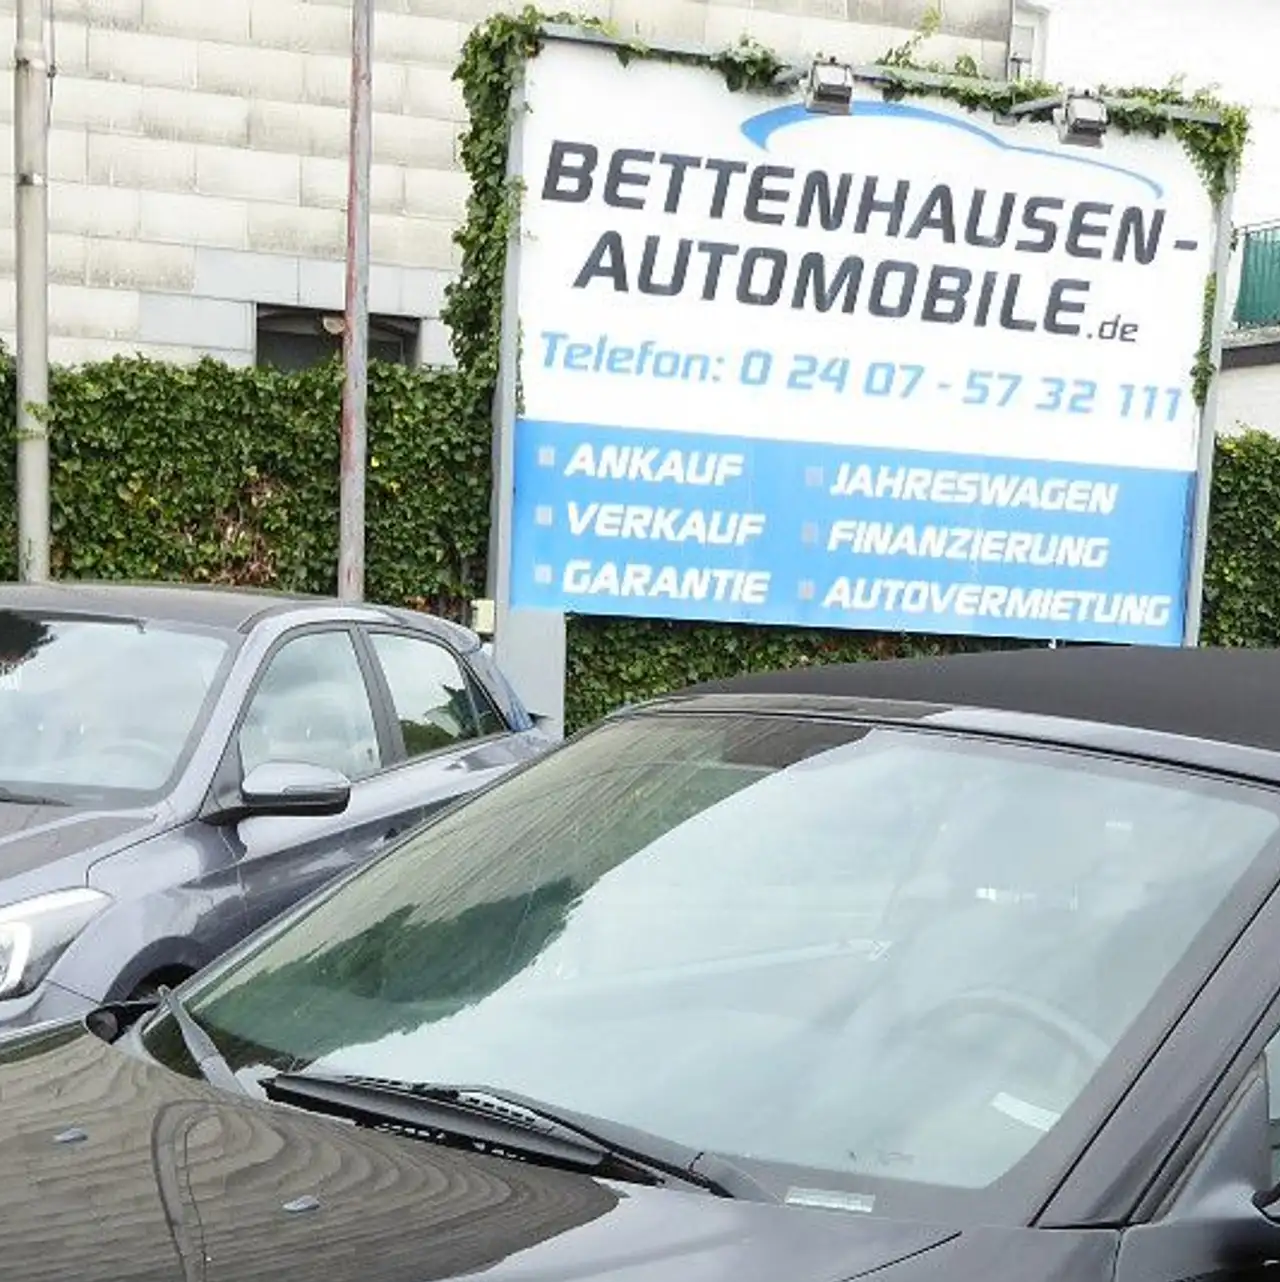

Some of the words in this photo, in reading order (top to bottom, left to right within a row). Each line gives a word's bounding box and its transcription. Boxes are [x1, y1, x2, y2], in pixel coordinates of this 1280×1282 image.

[540, 330, 726, 384] Telefon:
[739, 349, 774, 386] 0
[786, 354, 852, 394] 24
[863, 361, 926, 400] 07
[962, 368, 1023, 407] 57
[1034, 376, 1098, 414] 32
[1118, 383, 1183, 423] 111
[563, 442, 746, 487] ANKAUF
[829, 462, 1120, 515] JAHRESWAGEN
[566, 501, 767, 547] VERKAUF
[827, 520, 1111, 569] FINANZIERUNG
[562, 559, 772, 605] GARANTIE
[822, 576, 1173, 627] AUTOVERMIETUNG
